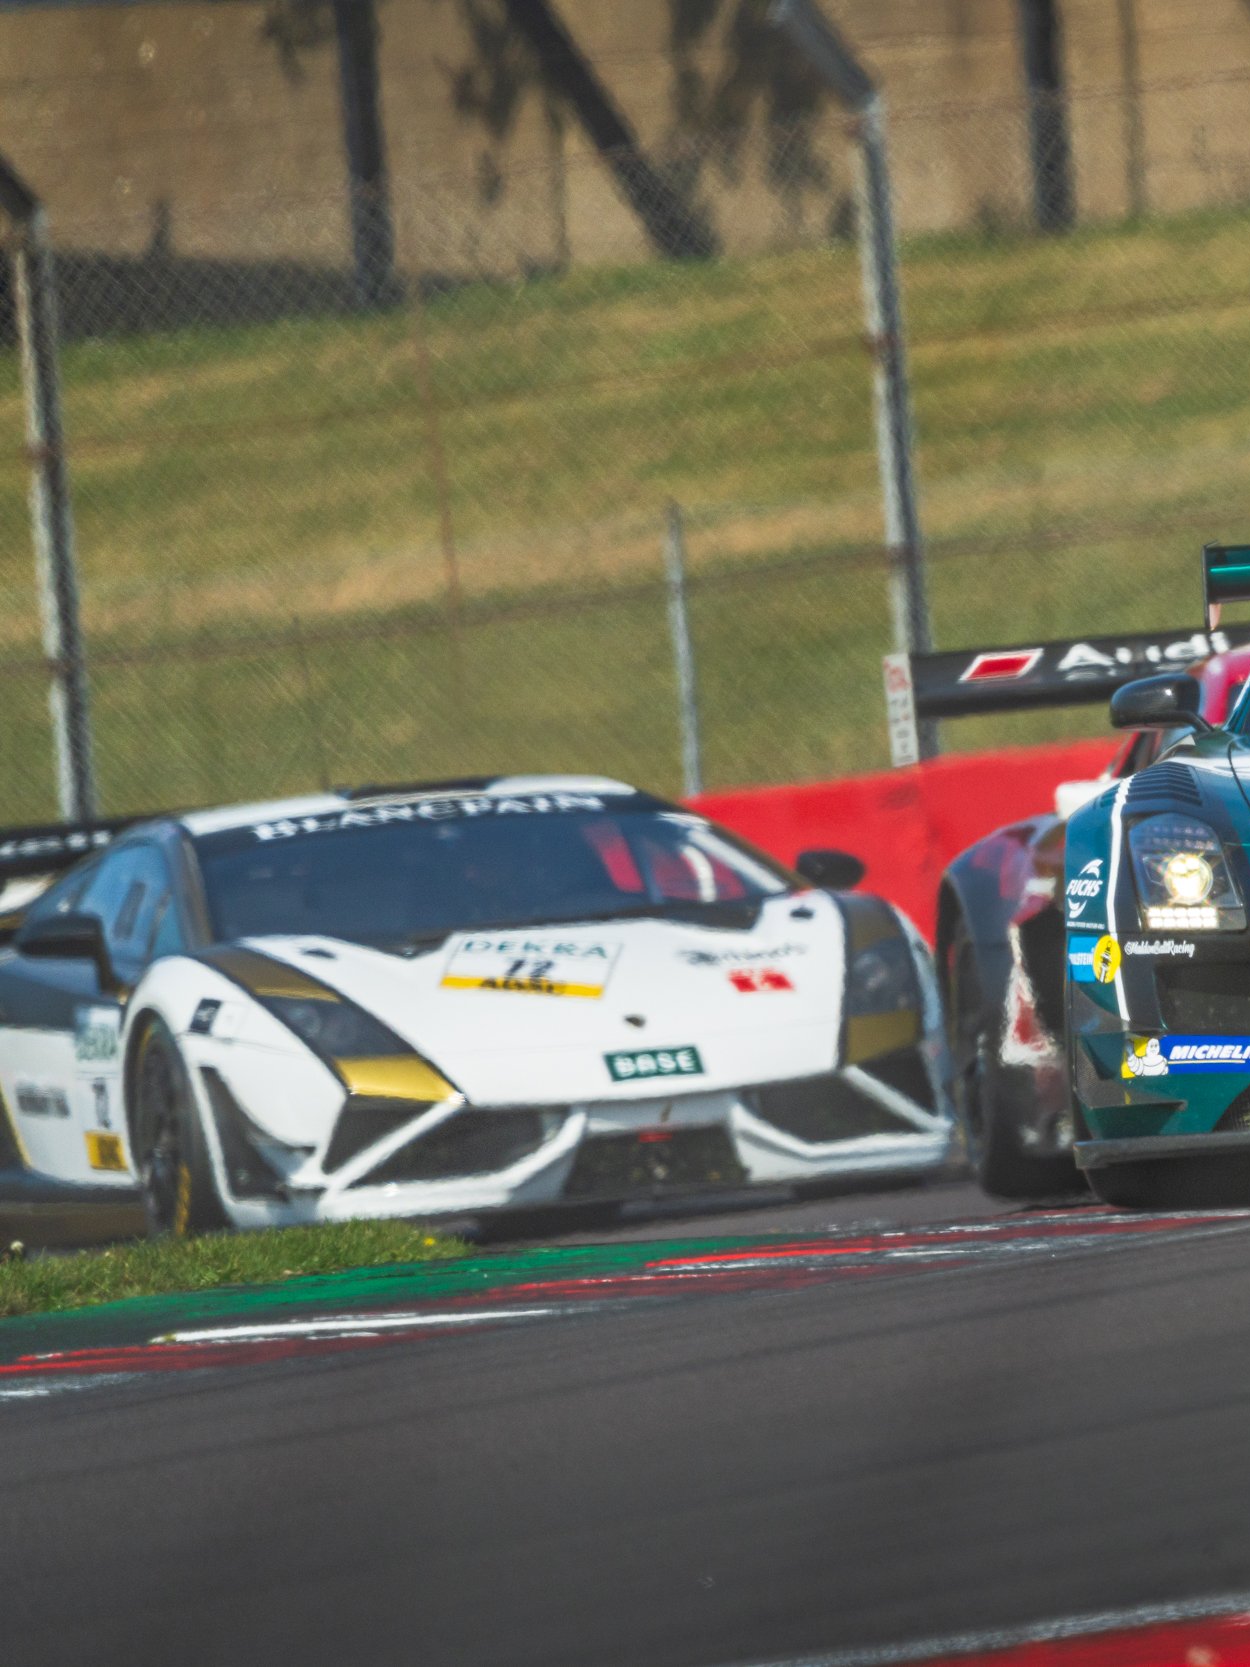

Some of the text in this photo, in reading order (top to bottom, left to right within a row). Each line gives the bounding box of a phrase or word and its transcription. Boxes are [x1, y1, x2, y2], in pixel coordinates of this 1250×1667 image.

[1056, 631, 1230, 671] Audi
[1066, 879, 1104, 897] FUCHS
[464, 940, 608, 959] DEKRA
[613, 1049, 697, 1078] BASE
